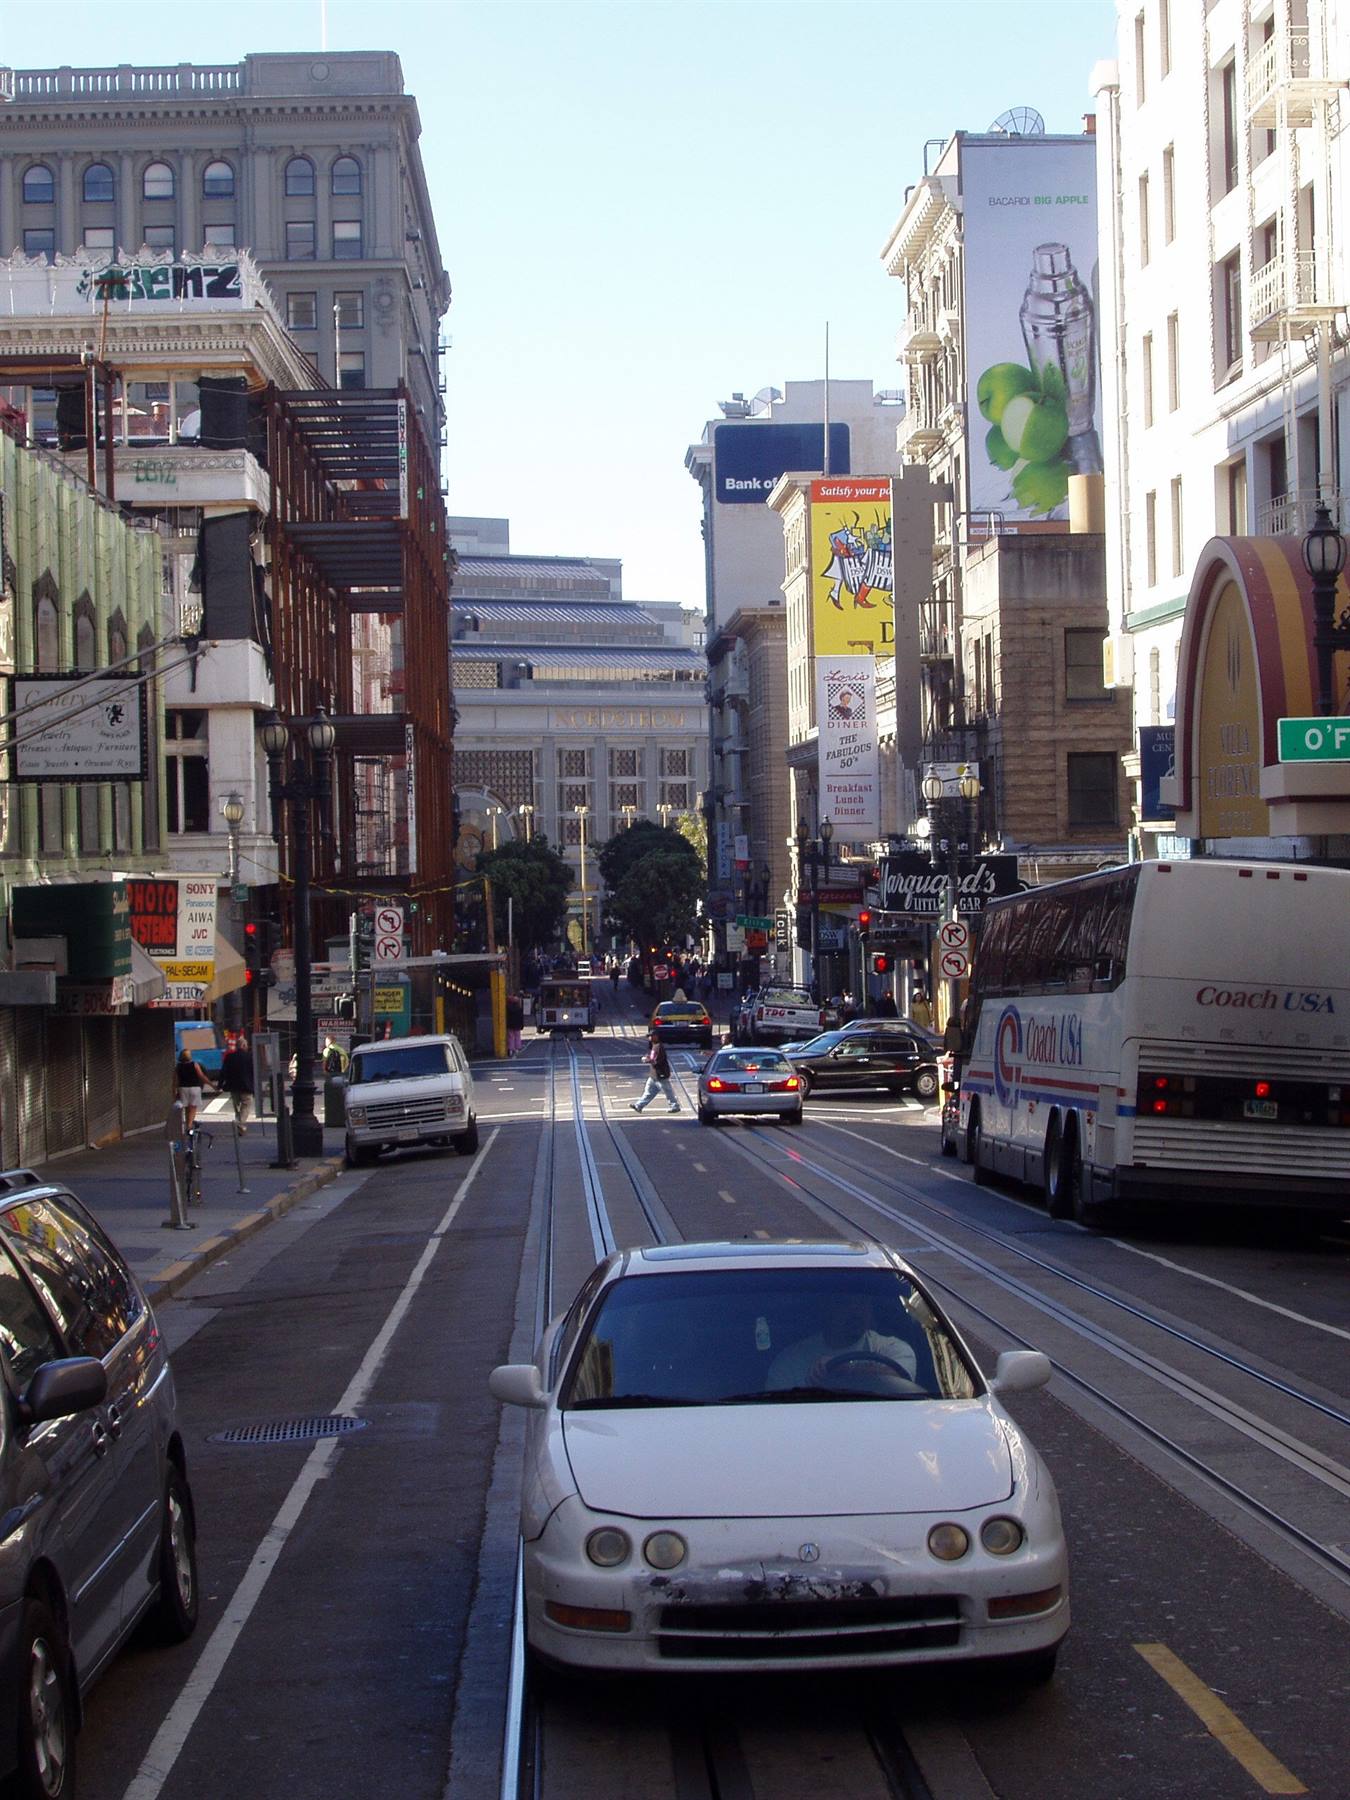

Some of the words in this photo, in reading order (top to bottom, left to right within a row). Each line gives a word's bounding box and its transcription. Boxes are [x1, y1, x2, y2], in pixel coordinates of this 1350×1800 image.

[988, 196, 1030, 207] BACARDI
[1034, 195, 1052, 205] BIG
[1055, 194, 1089, 205] APPLE
[725, 478, 759, 490] Bank
[820, 486, 853, 498] Satisfy
[855, 487, 878, 498] your
[823, 669, 870, 683] Lori's
[556, 710, 685, 729] NORDSTROM
[827, 720, 868, 729] DINER
[839, 733, 858, 746] THE
[96, 743, 138, 754] Furniture
[825, 742, 872, 761] FABULOUS
[839, 755, 858, 769] 50's
[826, 783, 873, 793] Breakfast
[835, 794, 864, 804] Lunch
[834, 806, 866, 816] Dinner
[186, 883, 215, 895] SONY
[186, 900, 215, 908] Panasonic
[188, 912, 214, 923] AIWA
[192, 928, 208, 939] JVC
[776, 913, 787, 946] fcuk
[166, 965, 208, 977] PAL-SECAM
[1196, 985, 1279, 1009] Coach
[1283, 991, 1336, 1014] USA
[764, 1008, 786, 1017] TDG
[1026, 1015, 1057, 1063] Coach
[1060, 1013, 1082, 1065] USA
